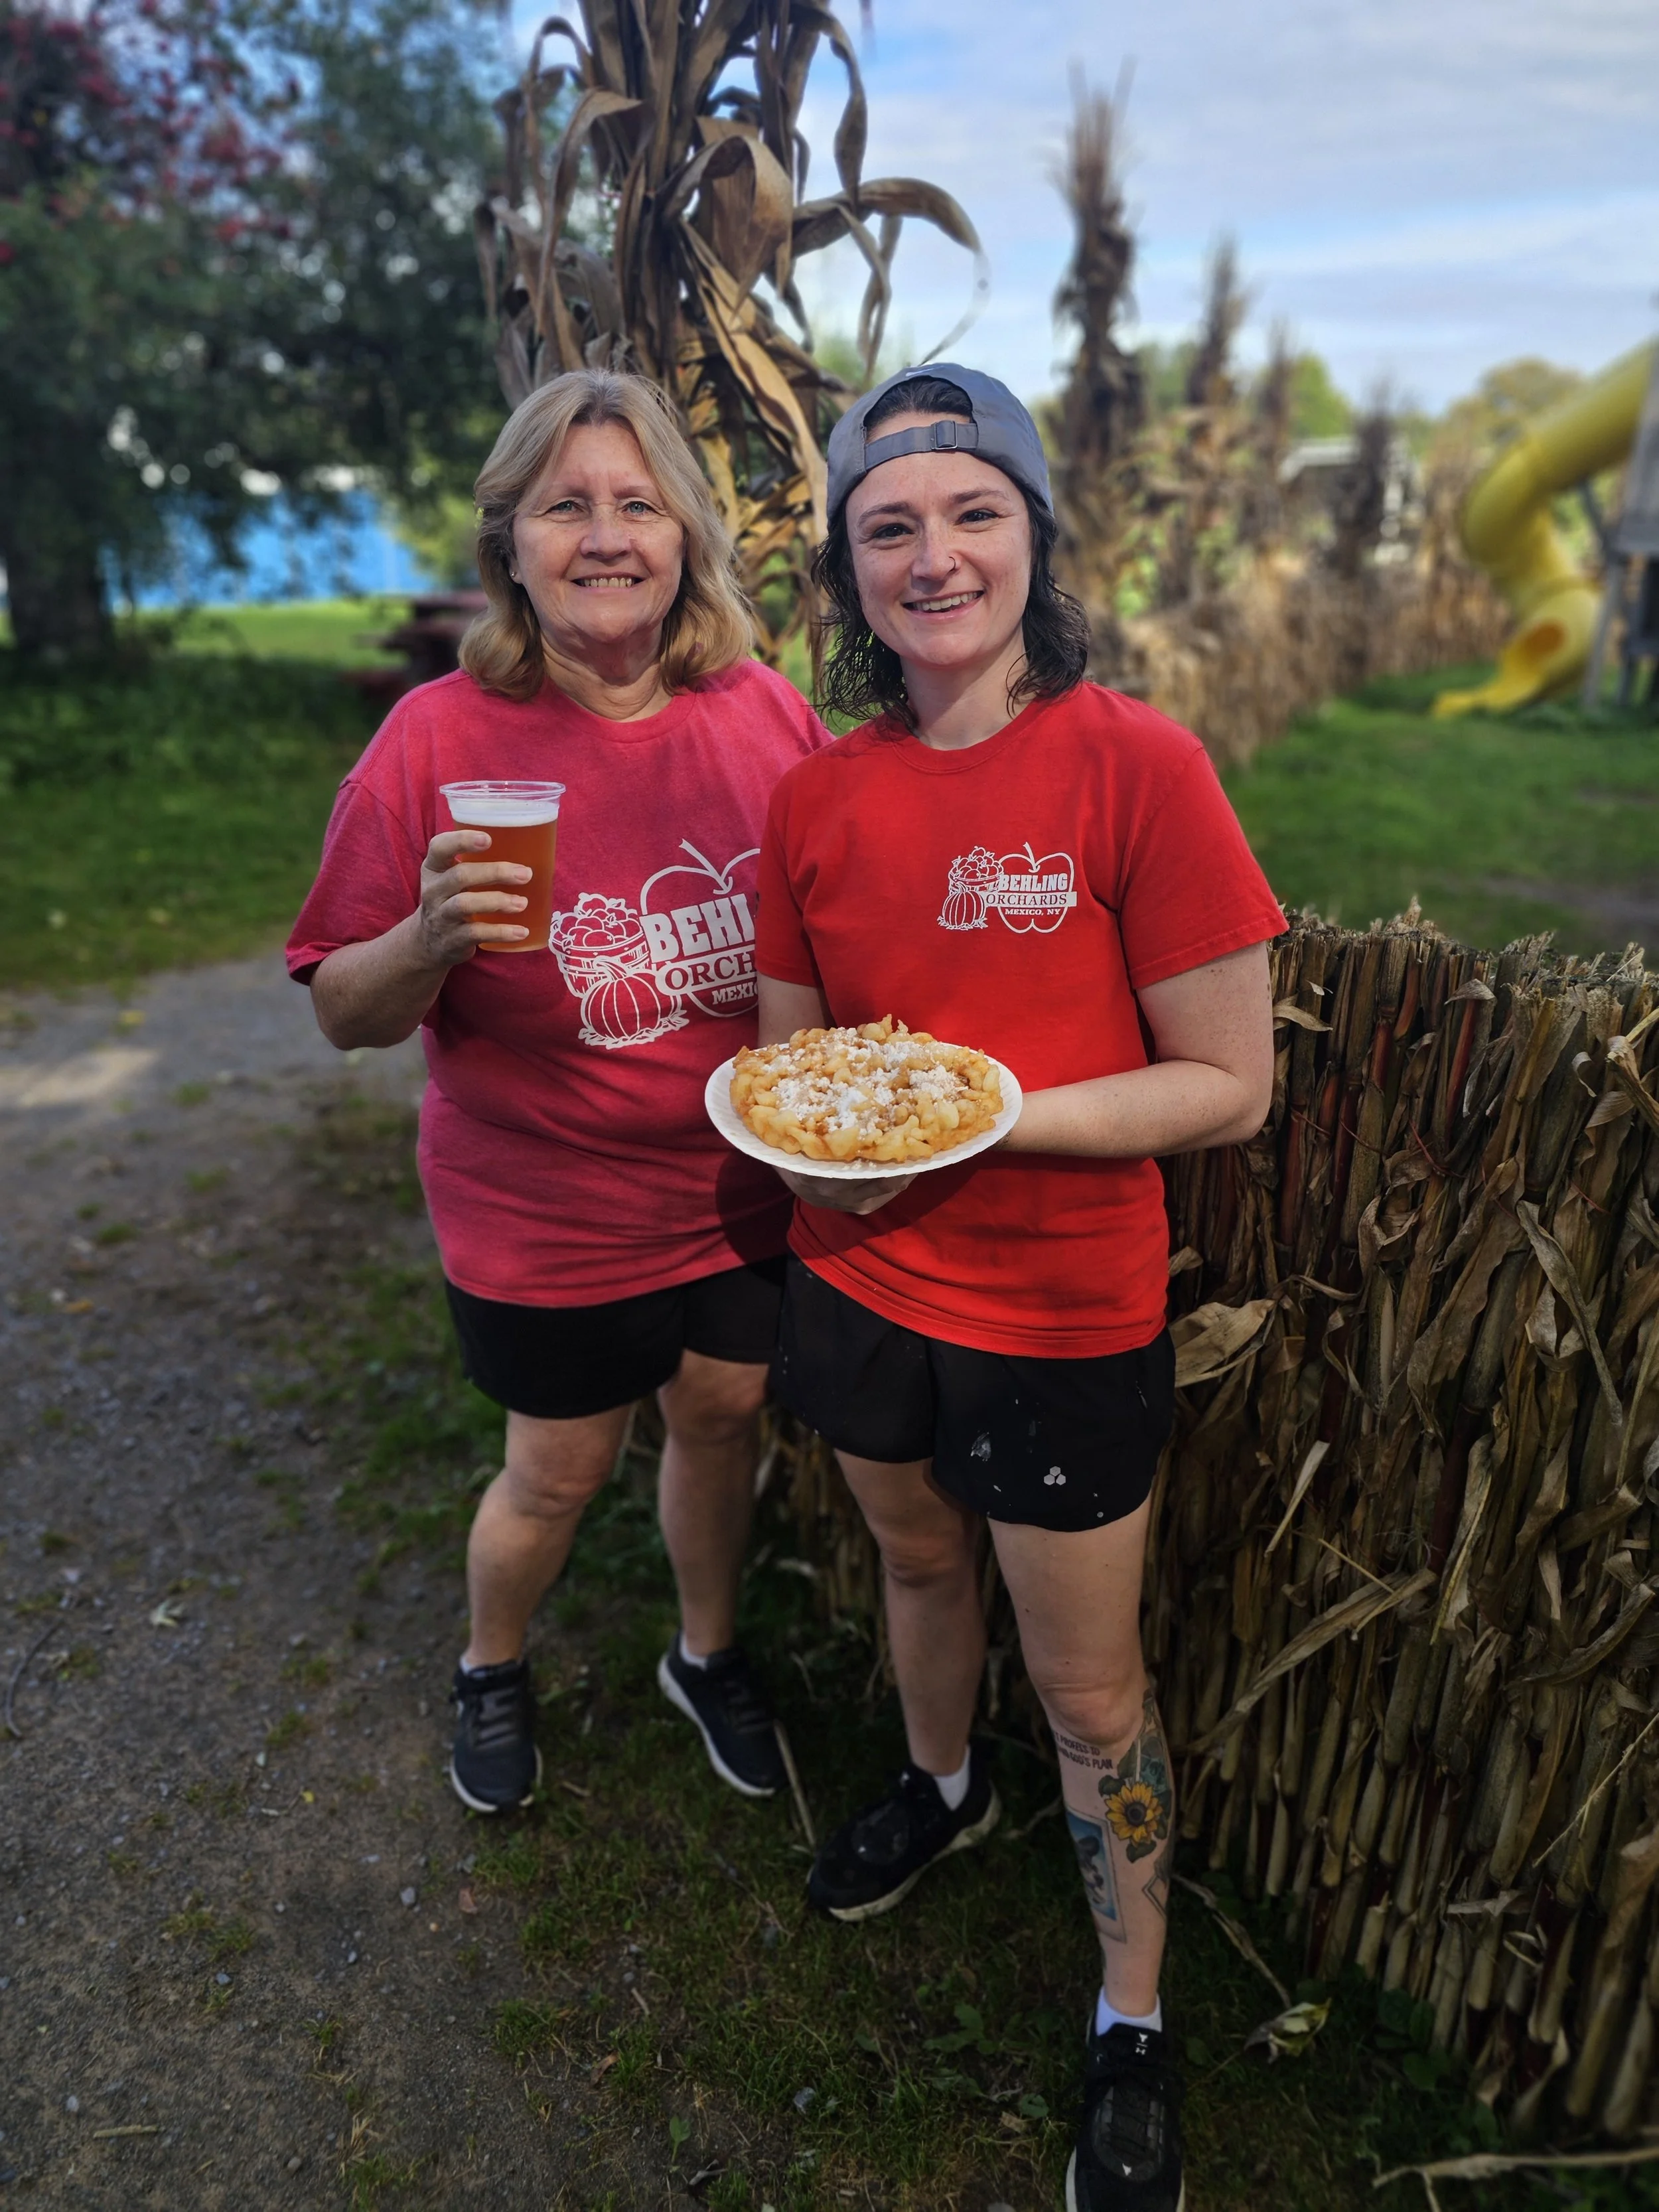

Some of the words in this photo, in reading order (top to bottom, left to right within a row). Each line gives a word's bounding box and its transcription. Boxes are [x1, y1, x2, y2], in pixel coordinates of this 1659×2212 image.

[998, 873, 1068, 891] BEHLING
[986, 893, 1067, 905] ORCHARDS
[1090, 1746, 1100, 1756] TO
[1092, 1759, 1114, 1769] PLAN
